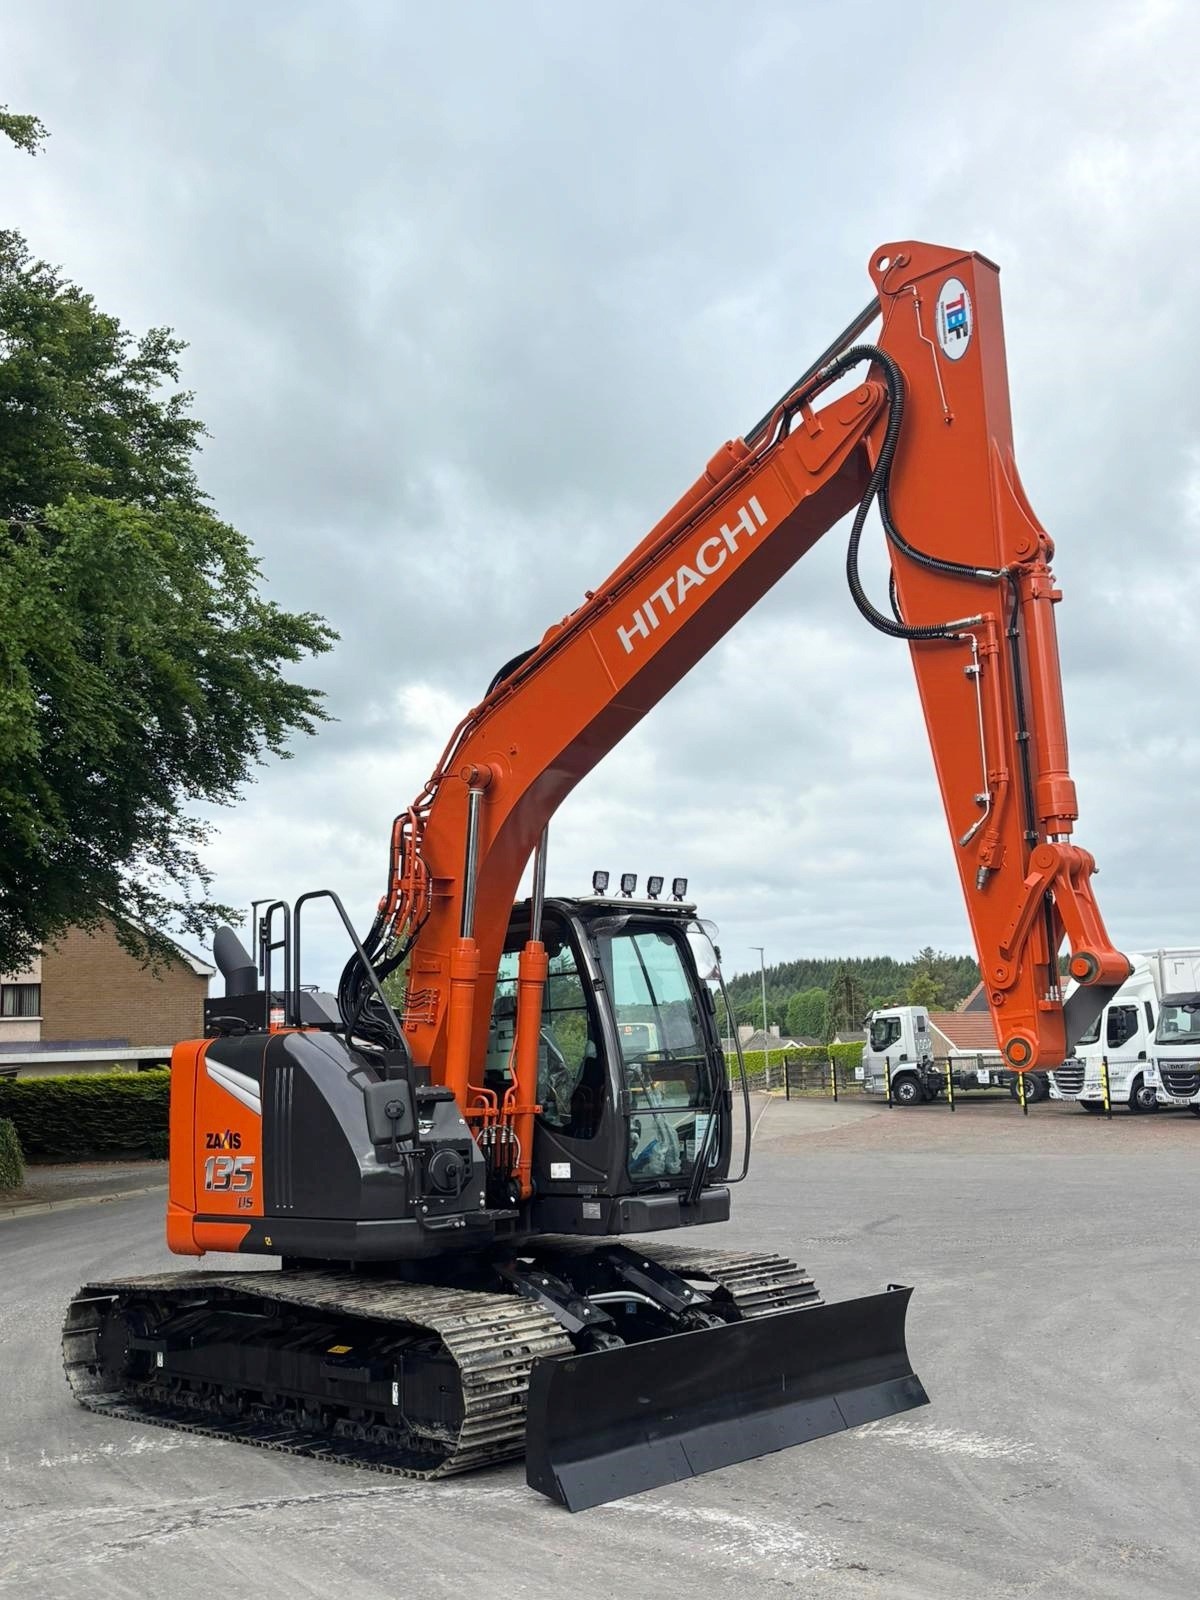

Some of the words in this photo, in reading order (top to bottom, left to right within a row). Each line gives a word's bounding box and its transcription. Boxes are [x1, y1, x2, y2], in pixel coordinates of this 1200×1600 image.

[617, 496, 768, 654] HITACHI
[206, 1130, 241, 1149] ZAXIS
[204, 1156, 256, 1191] 135
